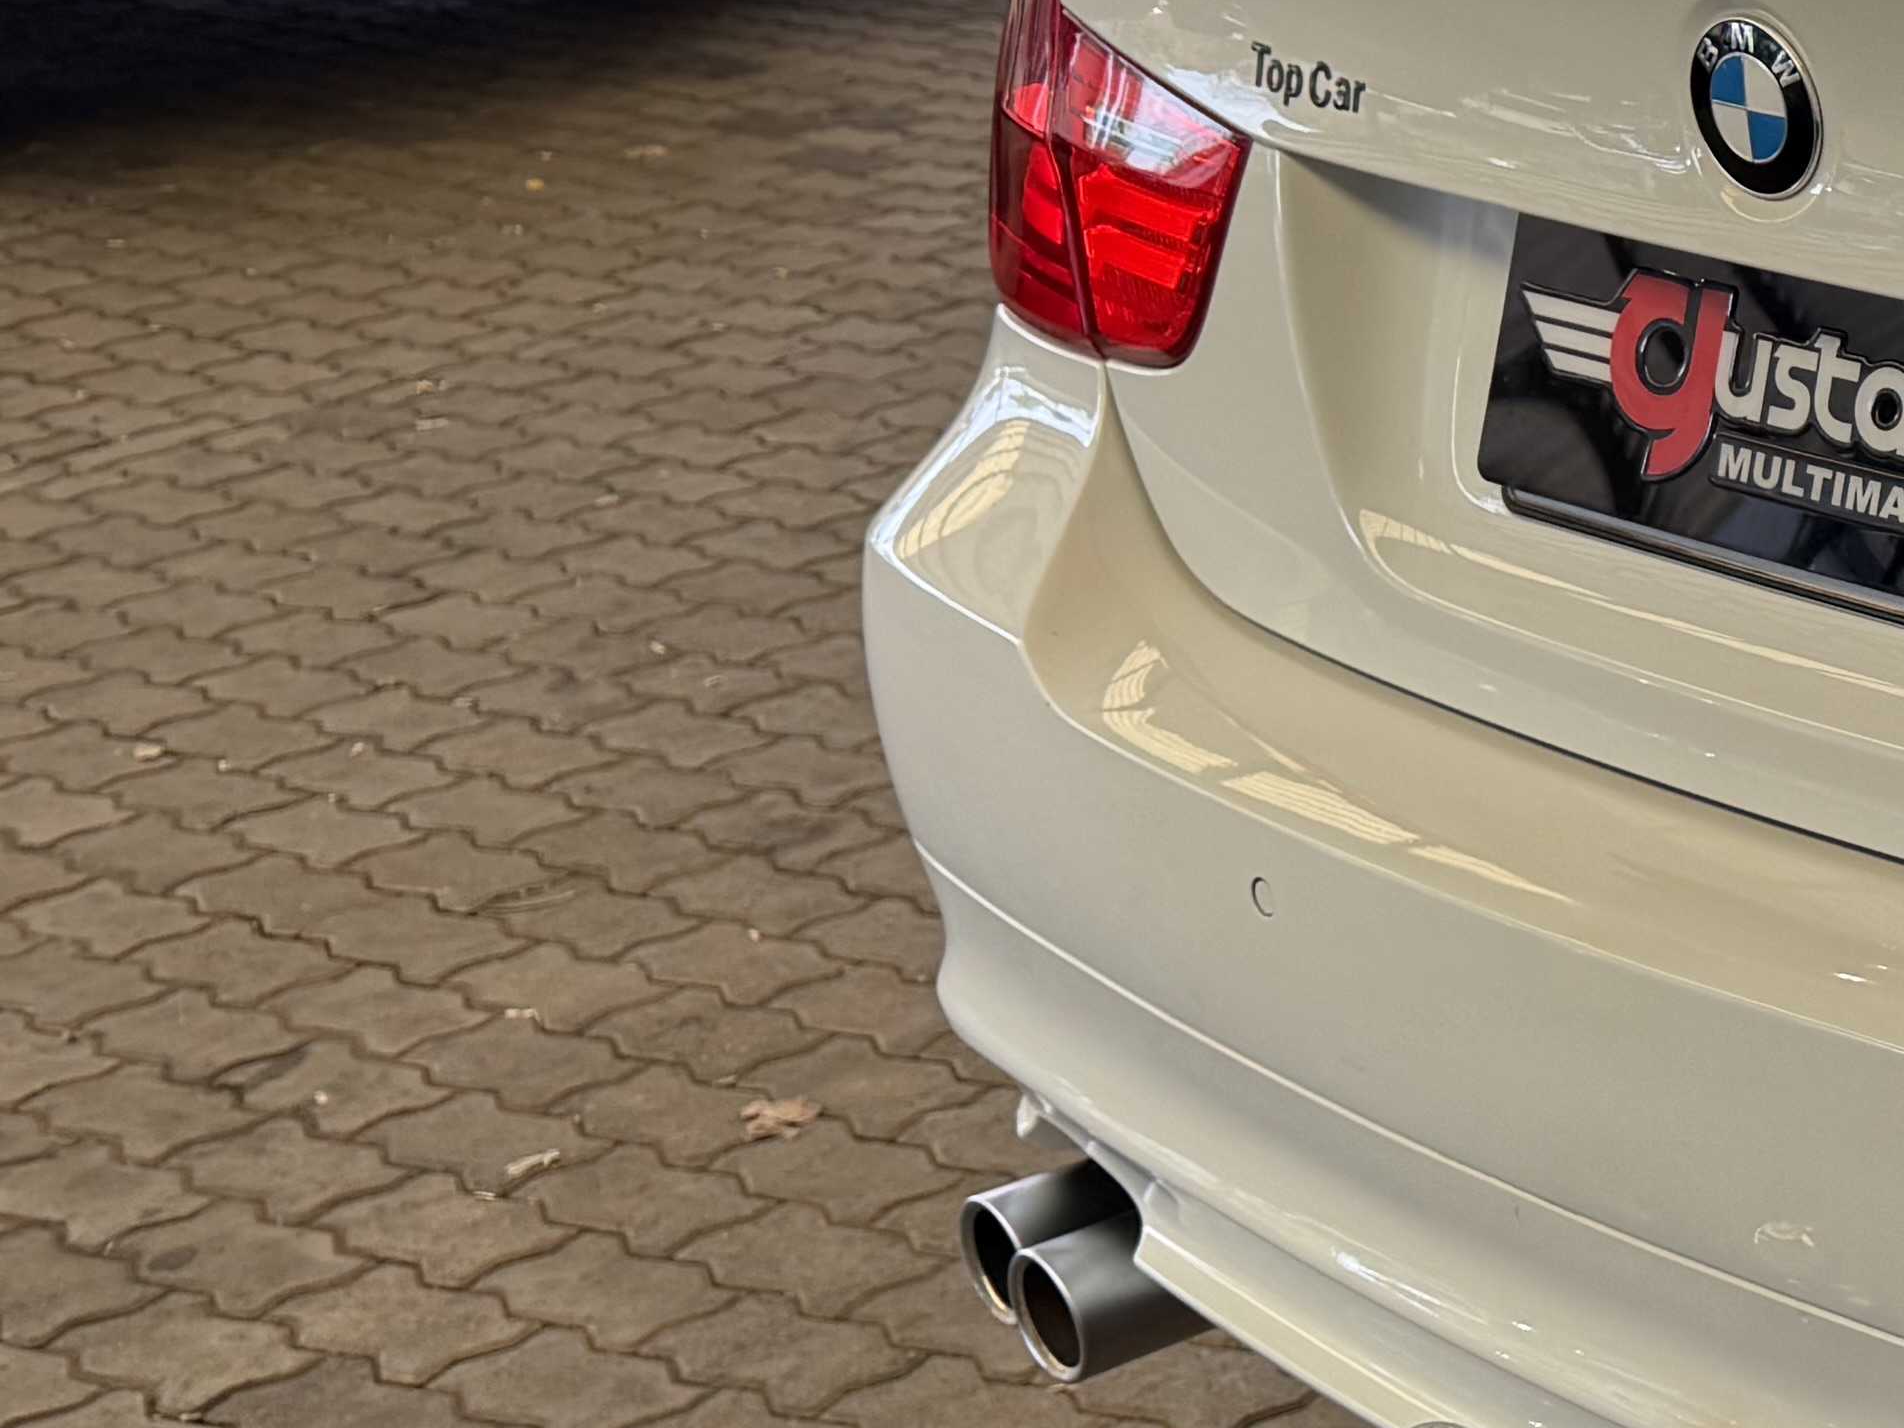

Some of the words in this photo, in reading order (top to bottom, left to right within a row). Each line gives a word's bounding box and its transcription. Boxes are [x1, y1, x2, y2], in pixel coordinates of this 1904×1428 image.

[1250, 41, 1305, 107] Top
[1308, 60, 1368, 114] Car
[1696, 21, 1801, 88] BMW
